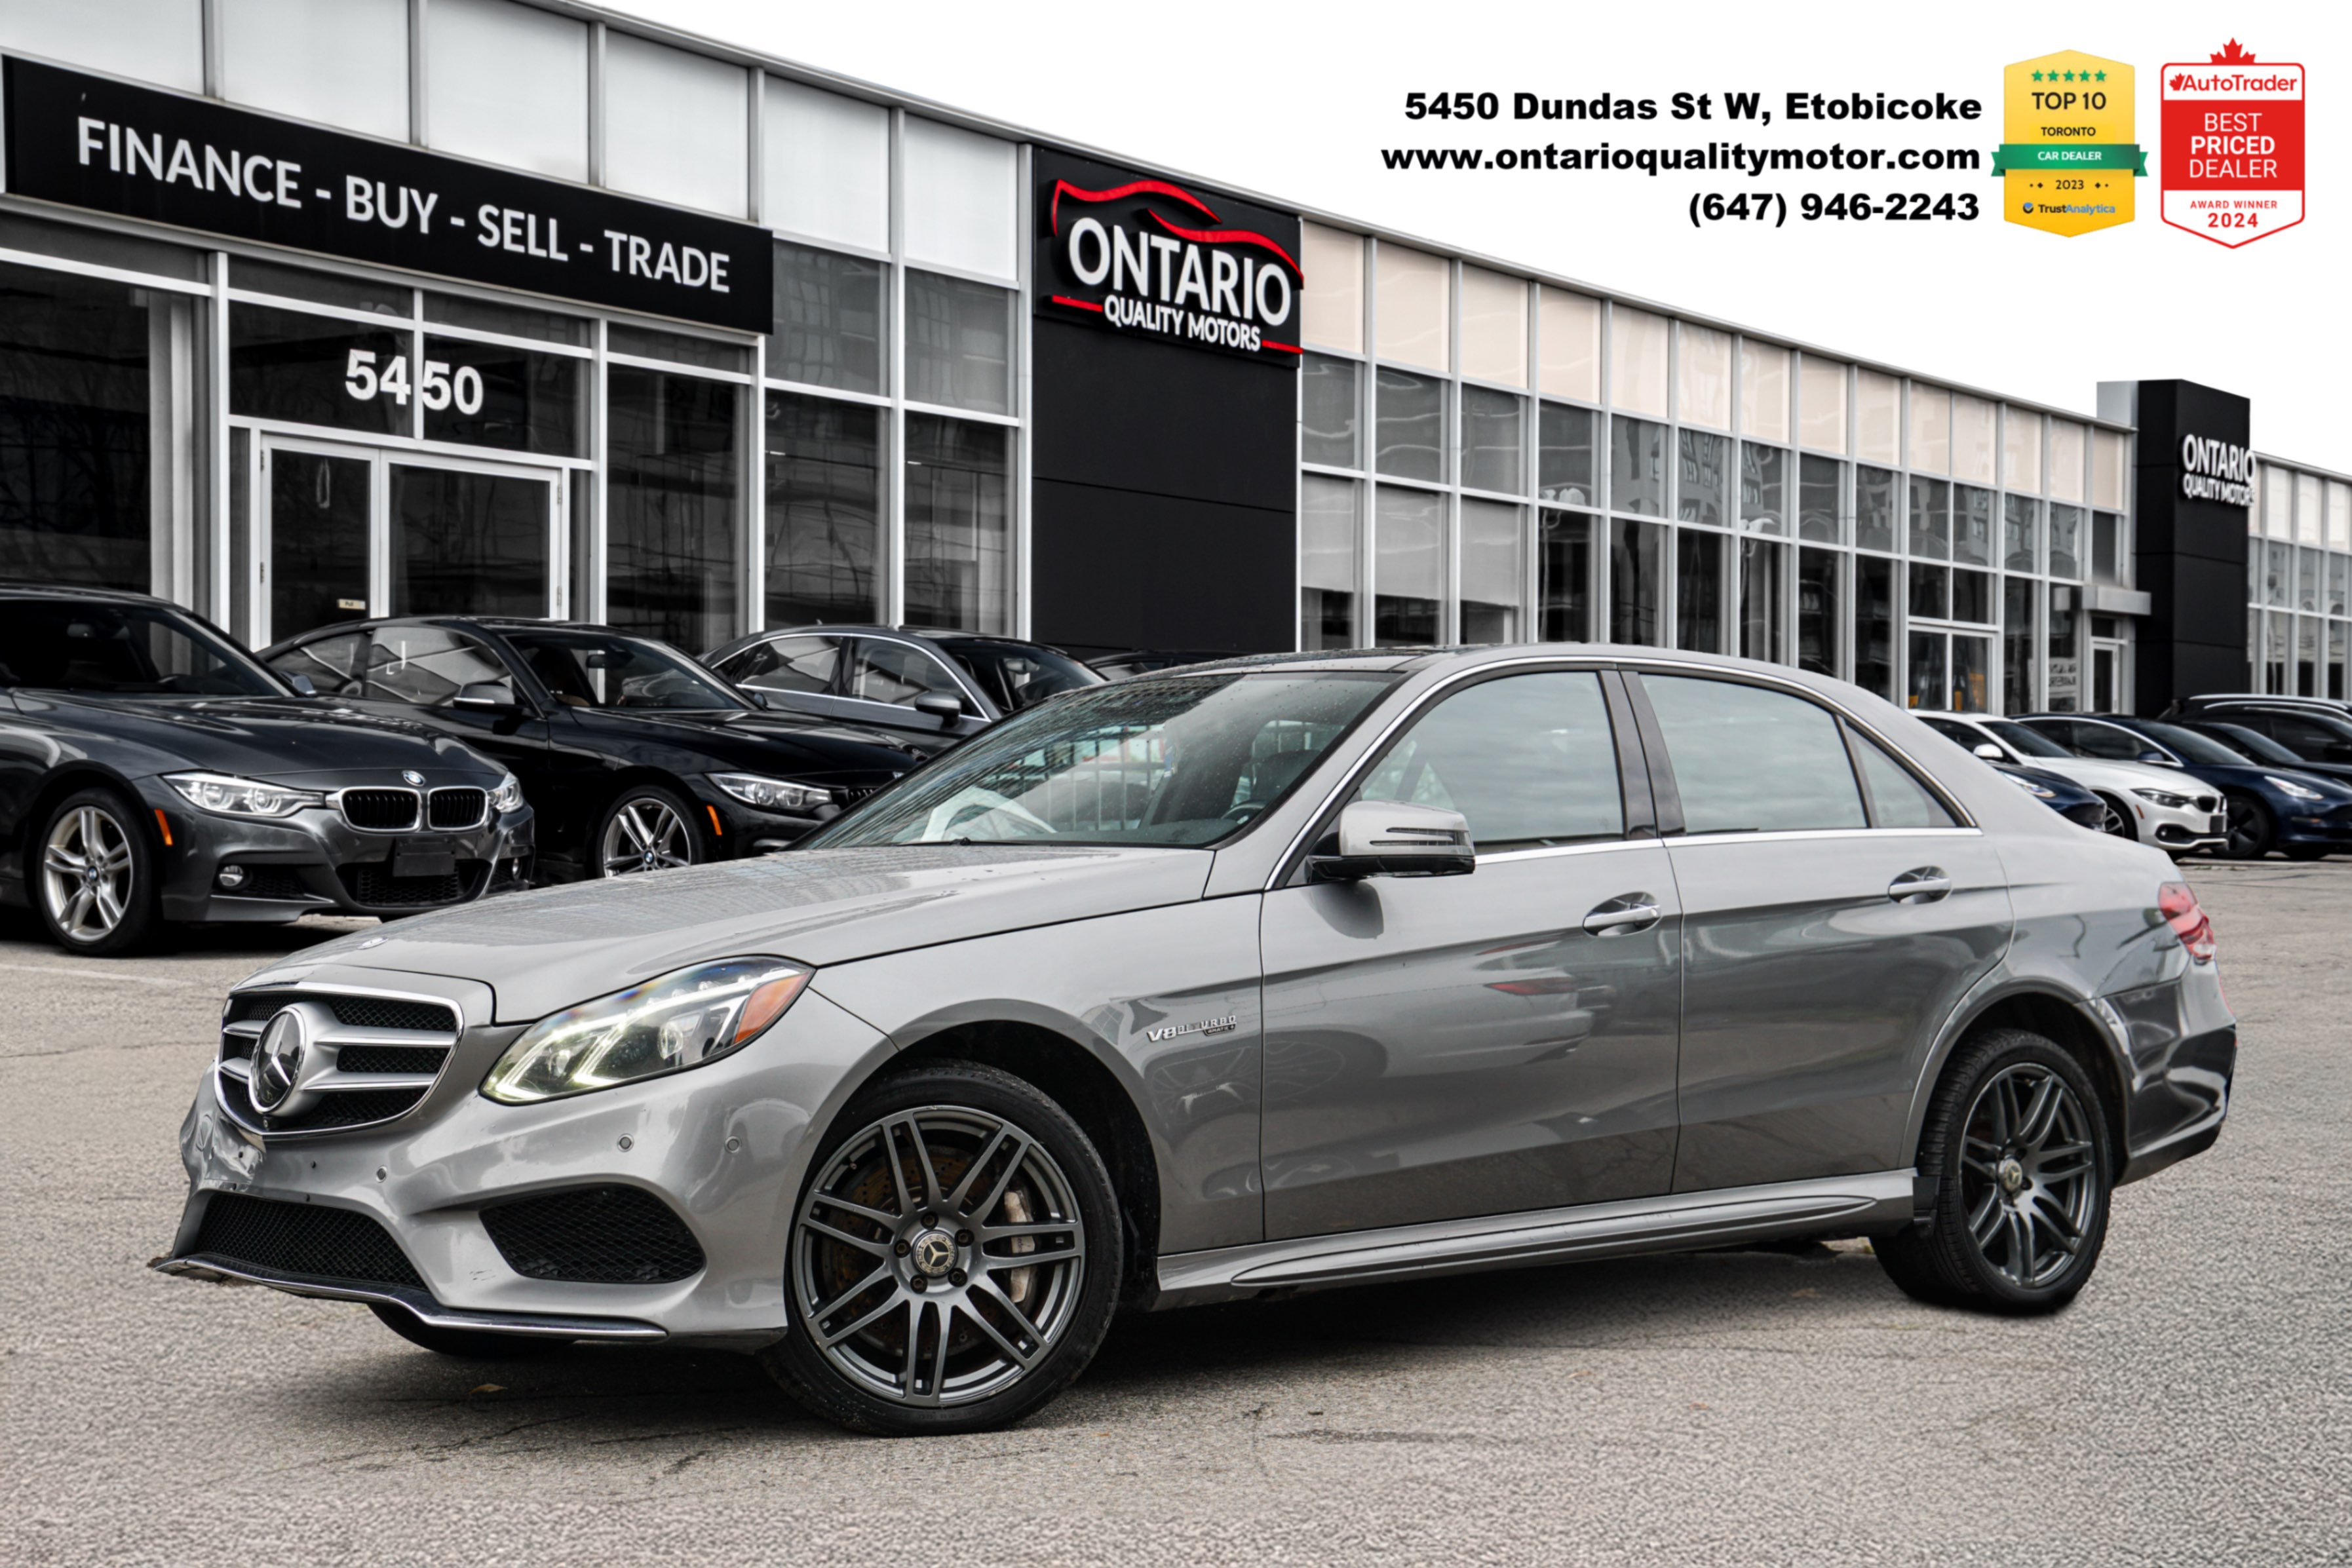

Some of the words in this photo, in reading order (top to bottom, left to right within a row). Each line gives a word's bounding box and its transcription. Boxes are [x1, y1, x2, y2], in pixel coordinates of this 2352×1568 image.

[78, 116, 301, 208] FINANCE
[346, 175, 438, 234] BUY
[478, 204, 568, 261] SELL
[604, 229, 729, 293] TRADE
[1069, 217, 1291, 326] ONTARIO
[1104, 294, 1184, 335] QUALITY
[1188, 312, 1261, 352] MOTORS
[345, 349, 483, 415] 5450
[2183, 434, 2256, 486] ONTARIO
[2183, 472, 2220, 501] QUALITY
[1147, 1027, 1177, 1042] V8
